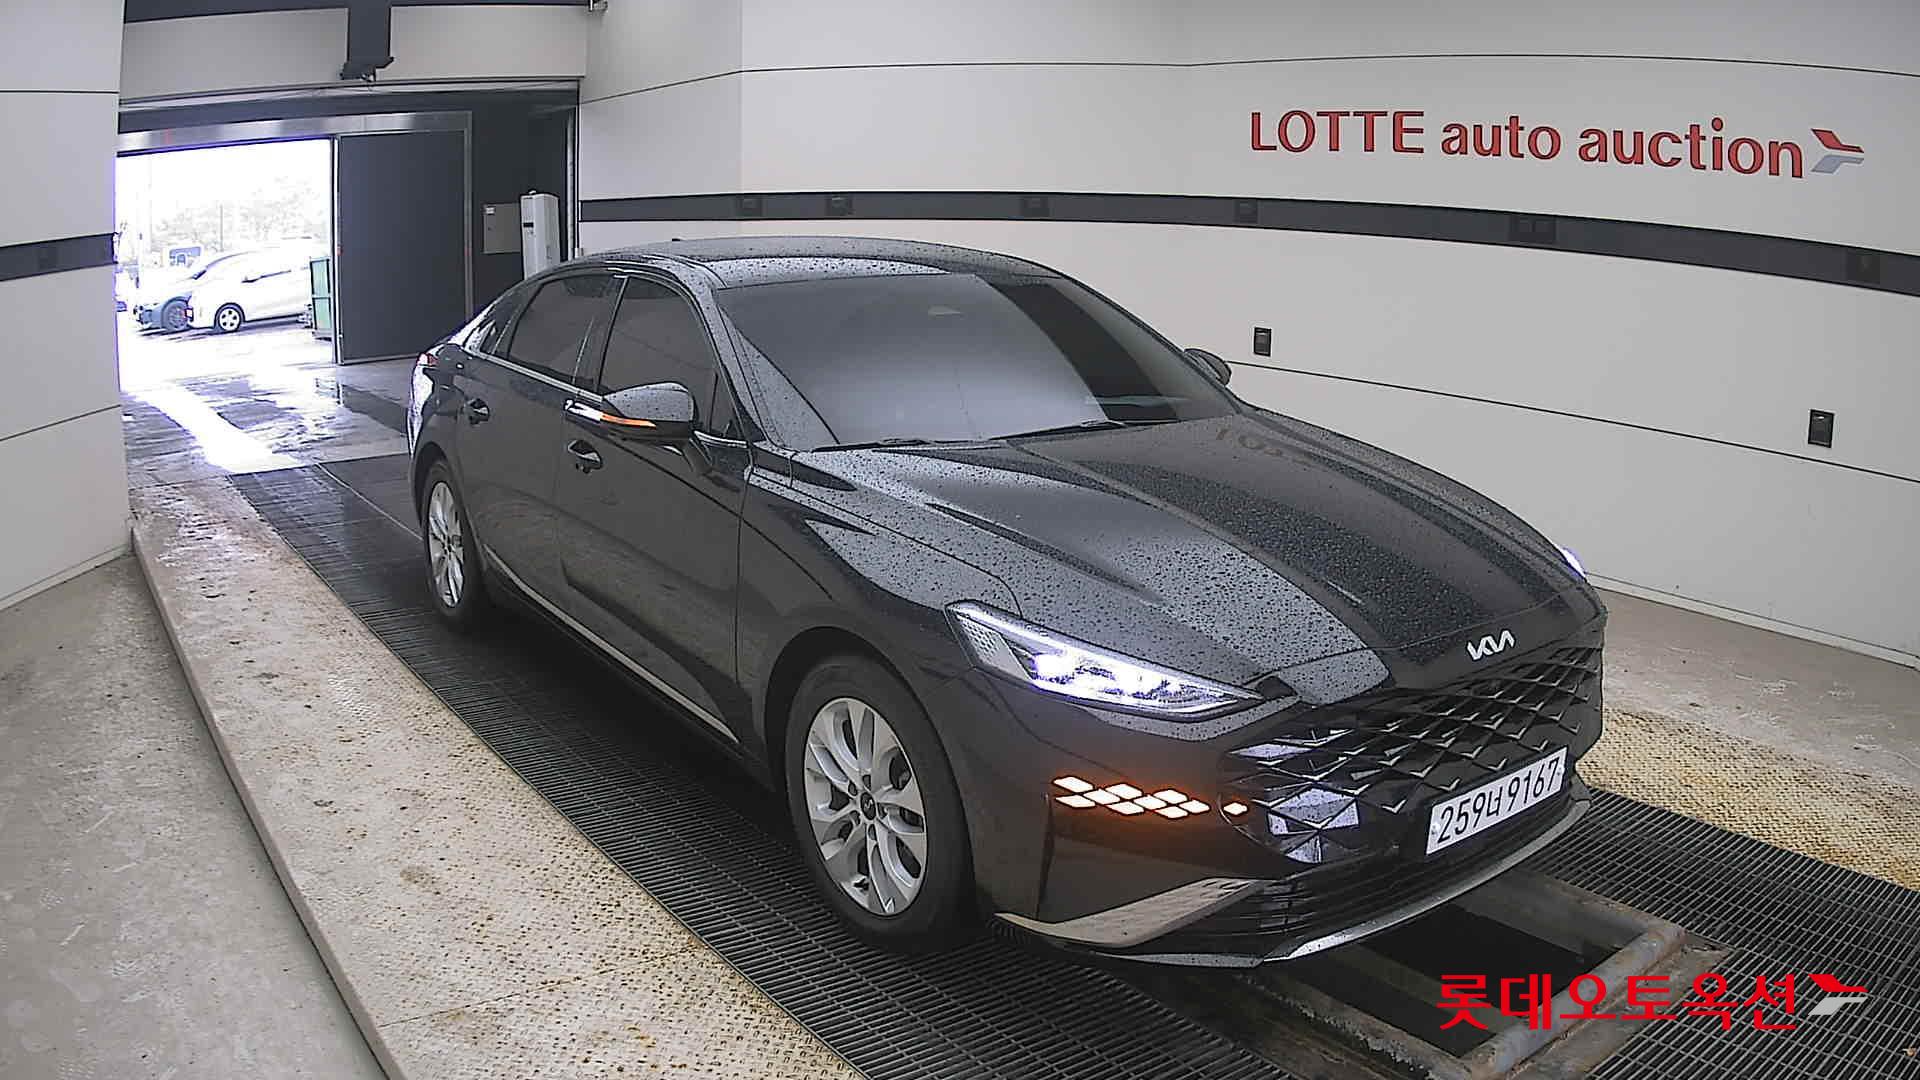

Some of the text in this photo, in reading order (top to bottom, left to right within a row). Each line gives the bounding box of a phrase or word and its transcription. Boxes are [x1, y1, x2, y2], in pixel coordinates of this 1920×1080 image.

[1251, 110, 1803, 179] LOTTE auto auction
